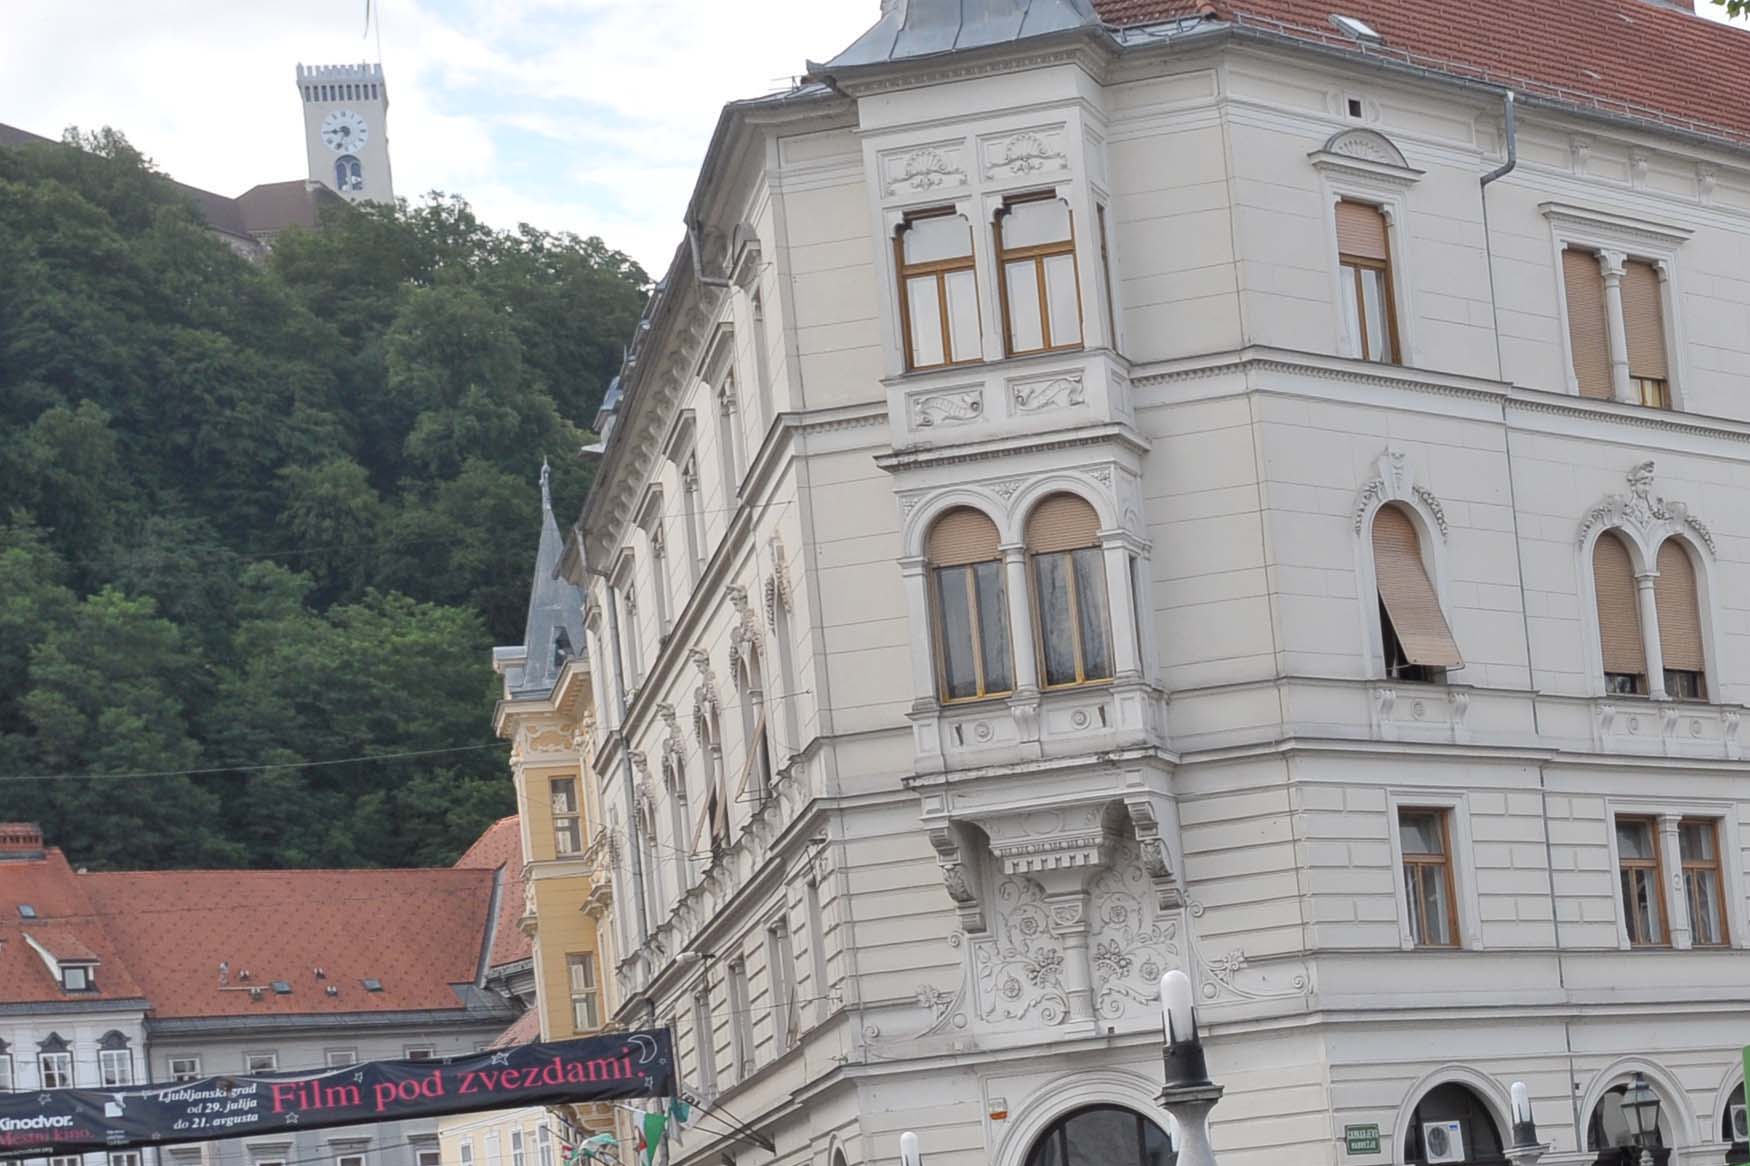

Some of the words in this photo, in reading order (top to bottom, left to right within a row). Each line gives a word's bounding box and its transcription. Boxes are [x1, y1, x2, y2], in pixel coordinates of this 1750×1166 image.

[271, 1081, 364, 1114] Film
[373, 1069, 446, 1112] pod
[456, 1046, 648, 1096] zvezdami.
[158, 1088, 227, 1103] Ljubljanski
[231, 1083, 257, 1098] grad
[187, 1103, 203, 1114] od
[224, 1097, 258, 1113] julija
[173, 1118, 189, 1130] do
[212, 1113, 259, 1127] avgusta
